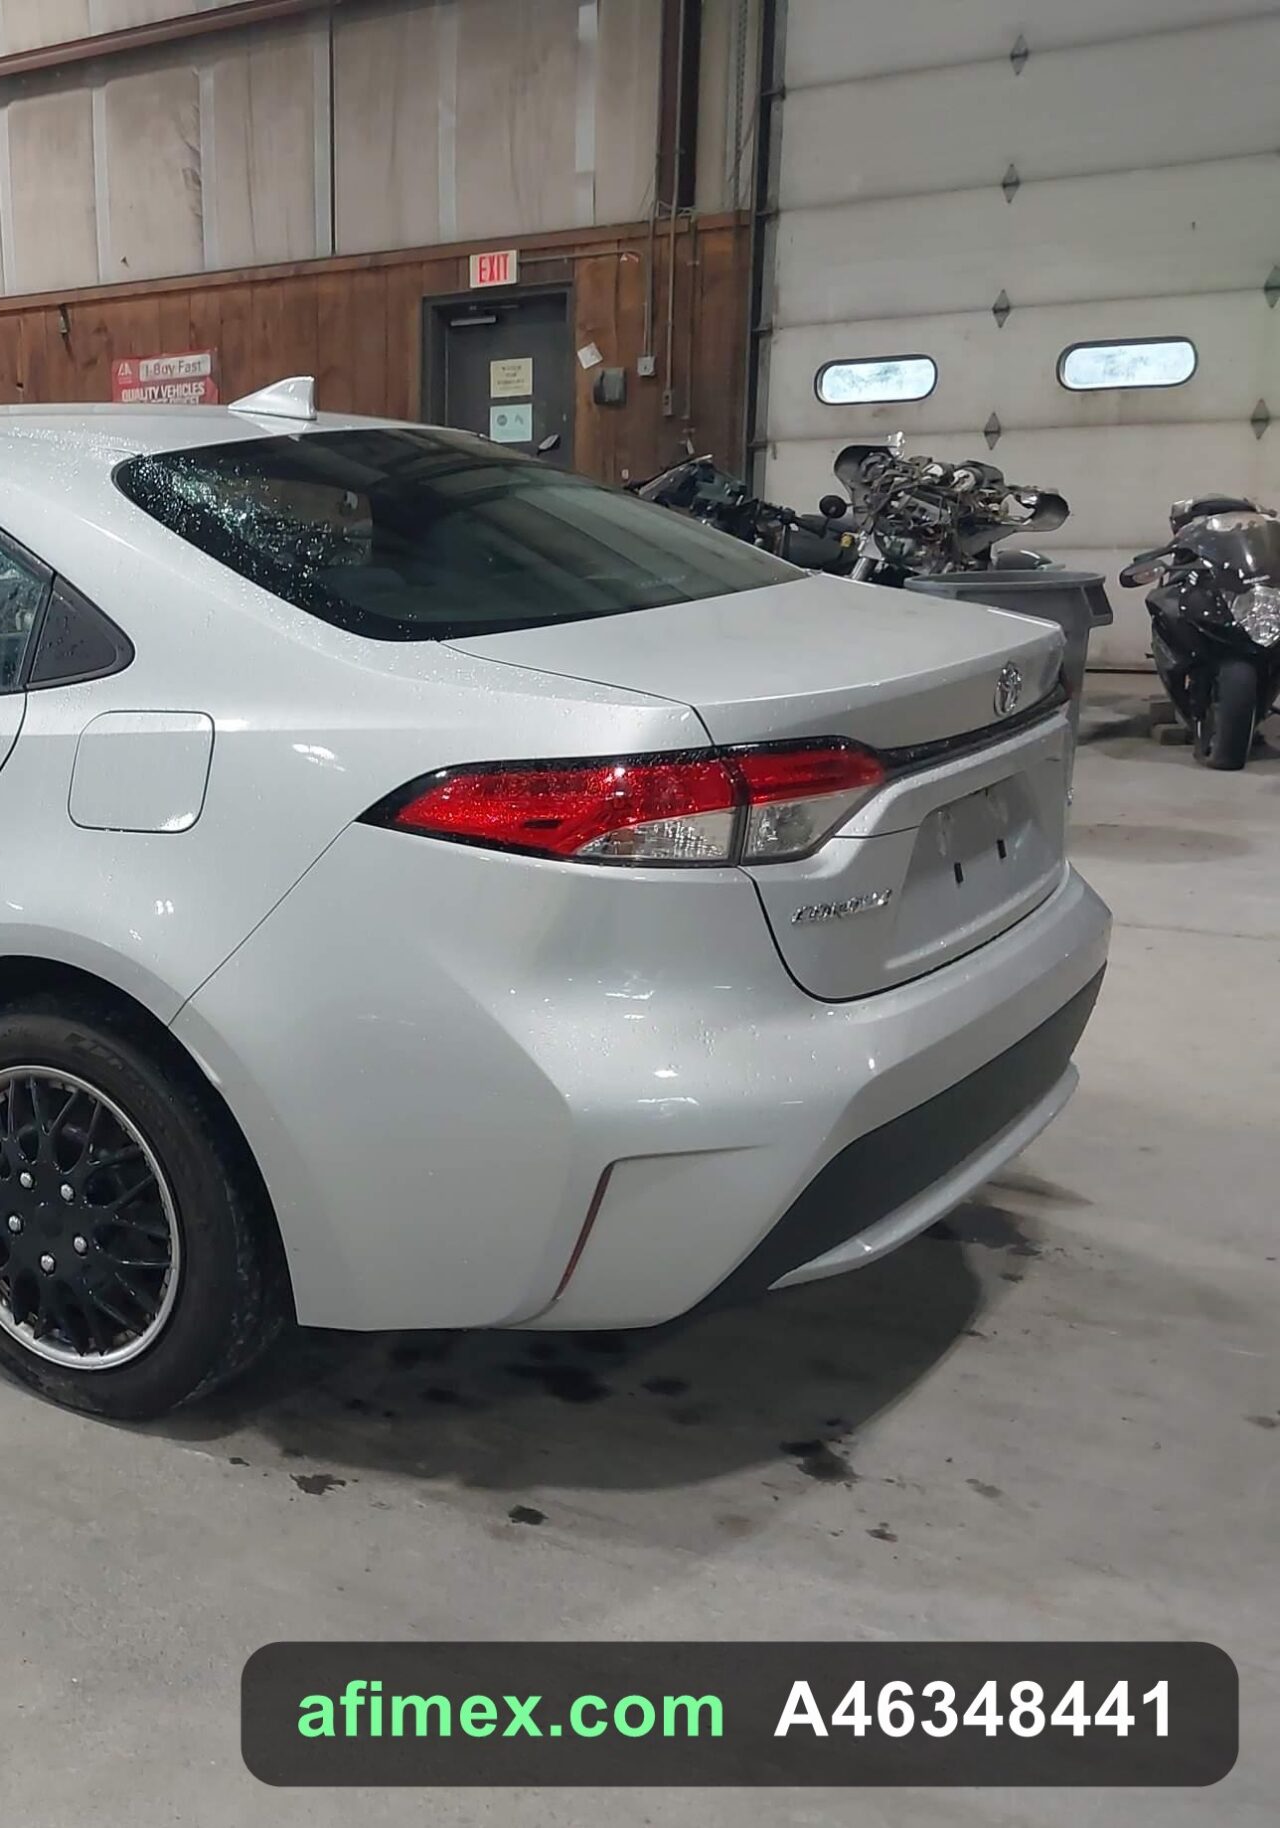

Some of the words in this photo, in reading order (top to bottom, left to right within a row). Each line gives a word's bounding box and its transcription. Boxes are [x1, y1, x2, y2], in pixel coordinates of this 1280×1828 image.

[479, 253, 510, 284] EXIT
[178, 360, 202, 374] Fast
[122, 386, 160, 402] QUALITY
[160, 381, 206, 400] VEHICLES
